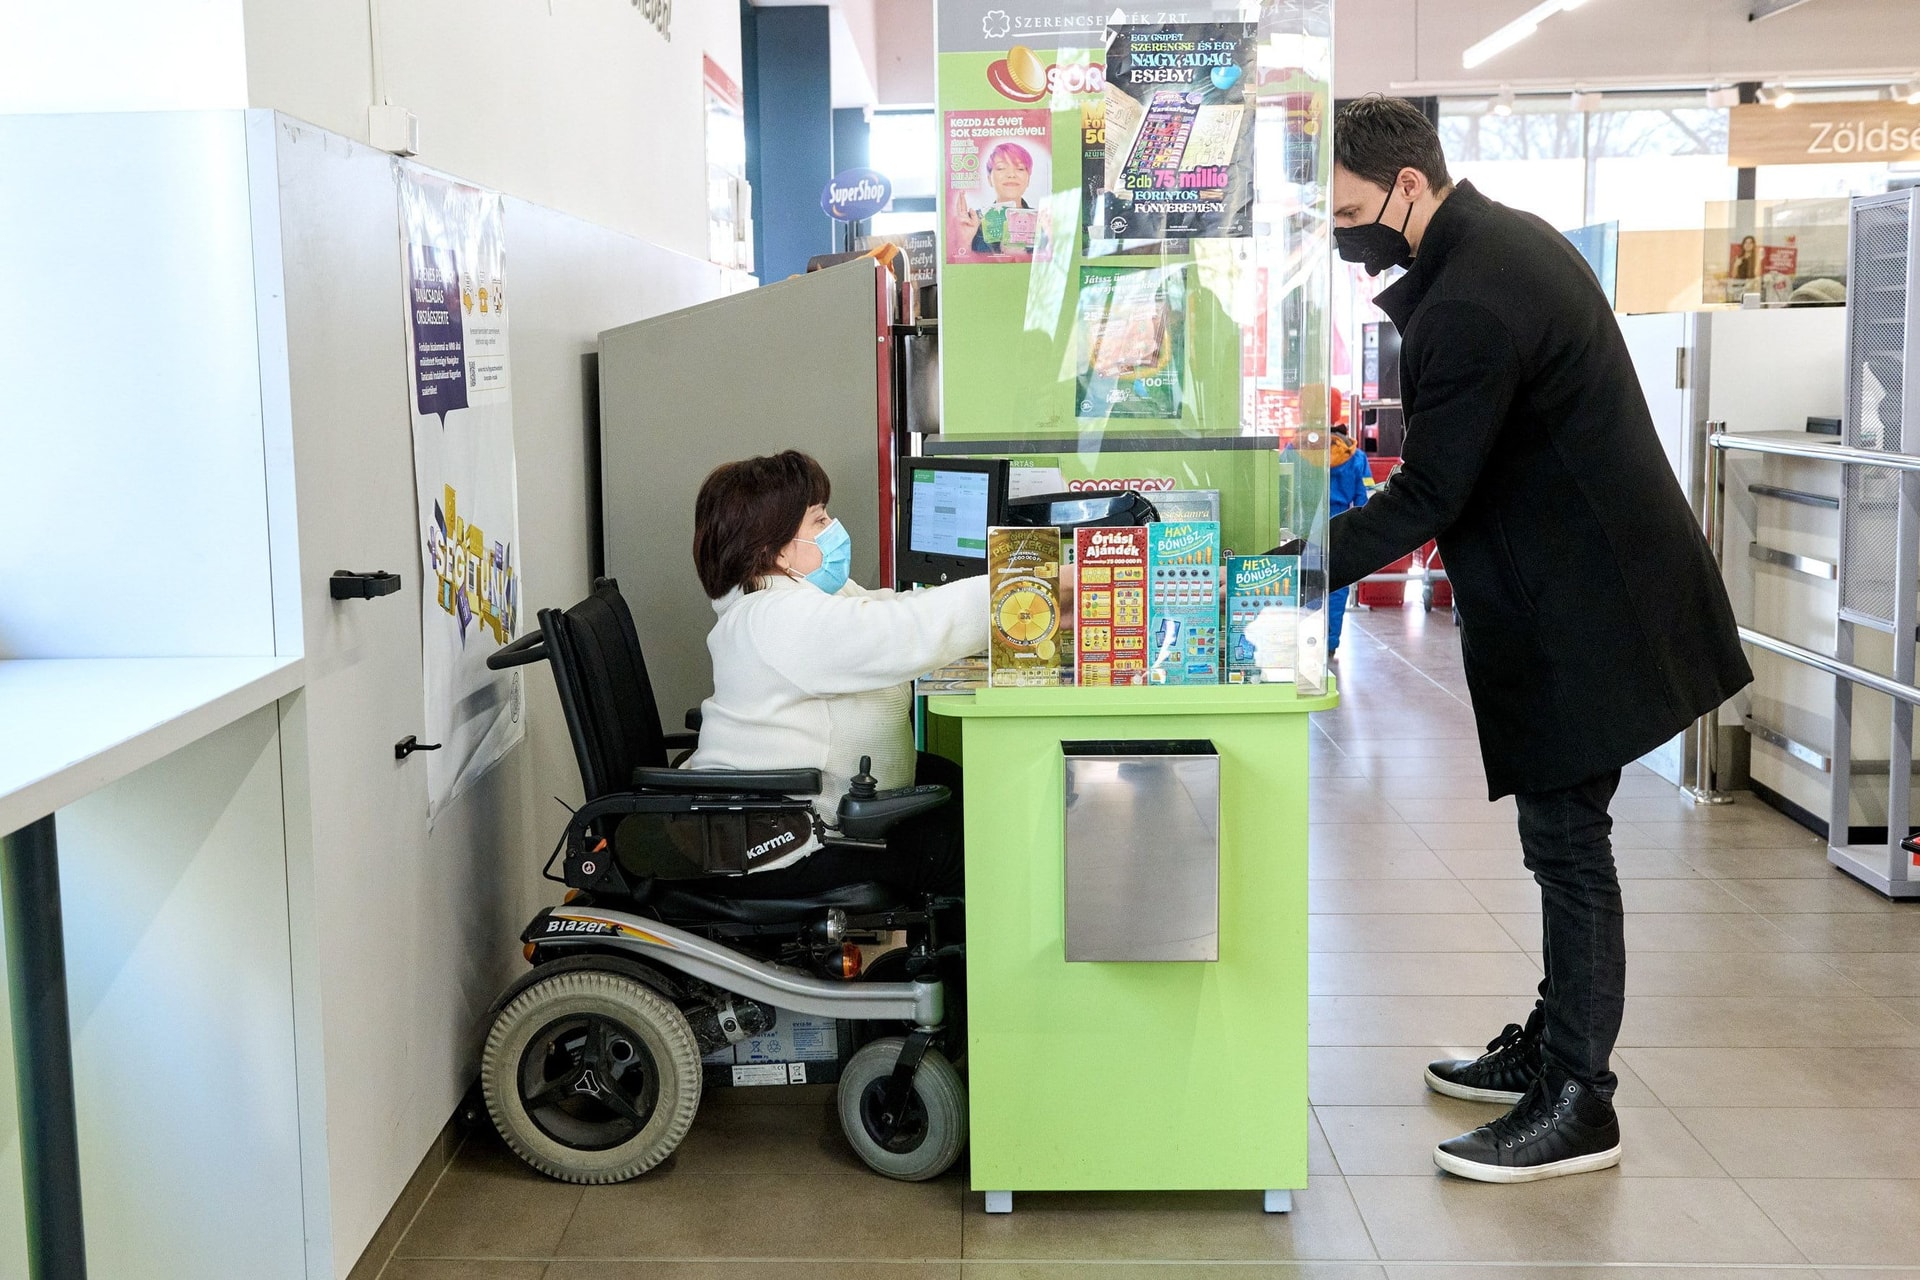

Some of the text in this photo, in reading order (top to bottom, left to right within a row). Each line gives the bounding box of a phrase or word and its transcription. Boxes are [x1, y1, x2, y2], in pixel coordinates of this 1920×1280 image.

[1130, 41, 1238, 52] SZERENCSE ÉS EGY
[1130, 52, 1233, 68] NAGY ADAG
[1130, 66, 1194, 83] ESÉLY!
[950, 116, 1023, 127] KEZDD AZ ÉVET
[950, 128, 970, 137] SOK
[950, 154, 979, 172] 50
[1155, 170, 1175, 188] 75
[1180, 167, 1229, 188] millió
[829, 180, 885, 207] SuperShop
[1135, 190, 1199, 201] FORINTOS
[1134, 200, 1228, 213] FŐNYEREMÉNY
[904, 235, 934, 251] Adjunk
[911, 253, 934, 267] esélyt
[1141, 377, 1162, 387] 100
[1091, 531, 1134, 545] Óriási
[1164, 524, 1193, 538] HAVI
[1158, 531, 1202, 551] BÓNUSZ
[1086, 543, 1140, 558] Ajándék
[1242, 557, 1271, 571] HETI
[1236, 563, 1280, 584] BÓNUSZ
[746, 831, 796, 860] karma
[546, 920, 607, 933] Blazer
